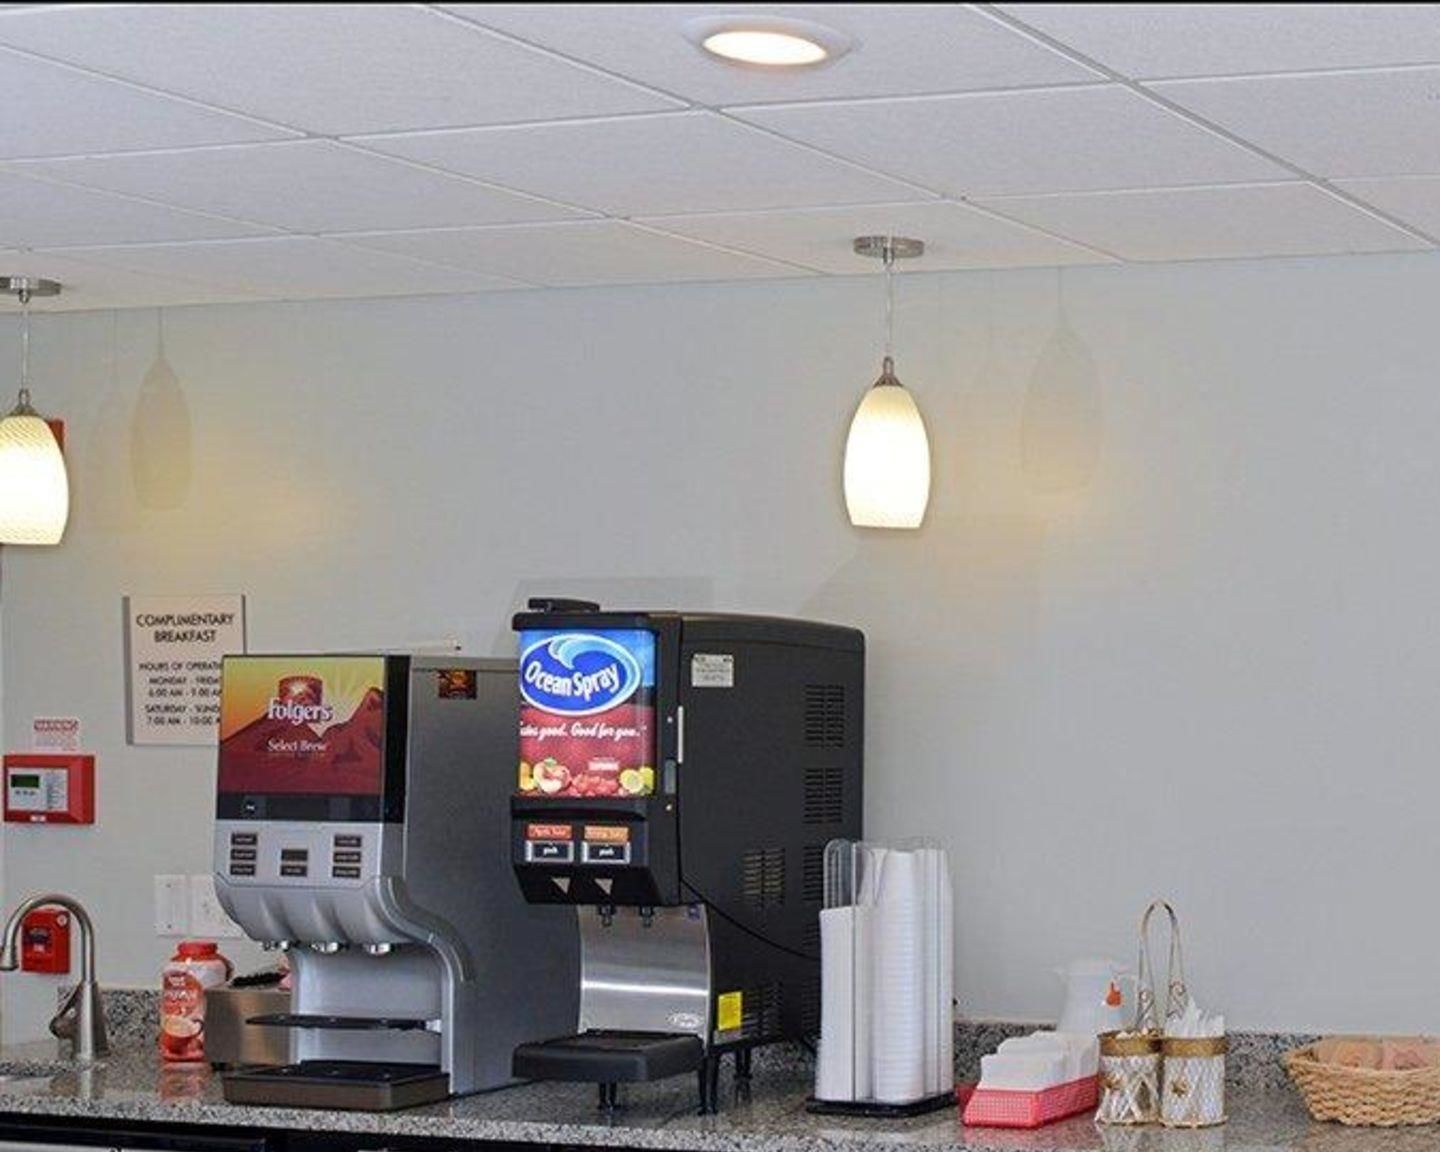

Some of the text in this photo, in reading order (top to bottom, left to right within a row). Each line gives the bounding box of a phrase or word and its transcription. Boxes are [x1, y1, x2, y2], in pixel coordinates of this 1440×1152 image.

[136, 613, 234, 627] COMPLIMENTARY
[154, 629, 216, 642] BREAKFAST
[524, 660, 620, 701] Ocean Spray
[267, 698, 333, 725] Folgers
[267, 738, 298, 752] Select
